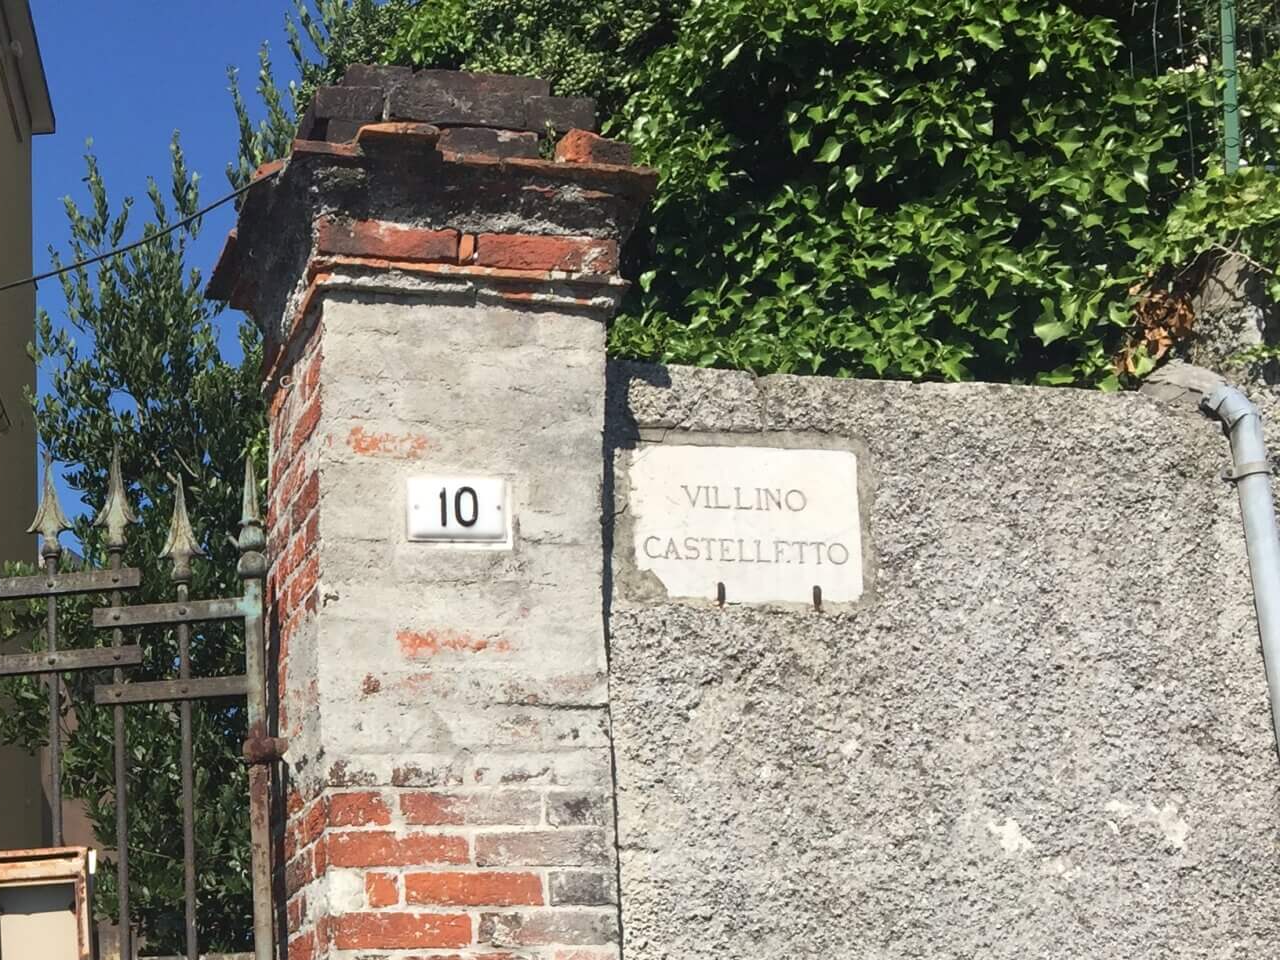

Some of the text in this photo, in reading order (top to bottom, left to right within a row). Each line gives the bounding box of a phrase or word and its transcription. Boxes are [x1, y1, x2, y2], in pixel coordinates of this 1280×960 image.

[439, 486, 479, 528] 10
[680, 485, 808, 512] VILLINO
[642, 535, 850, 566] CASTELLETTO
